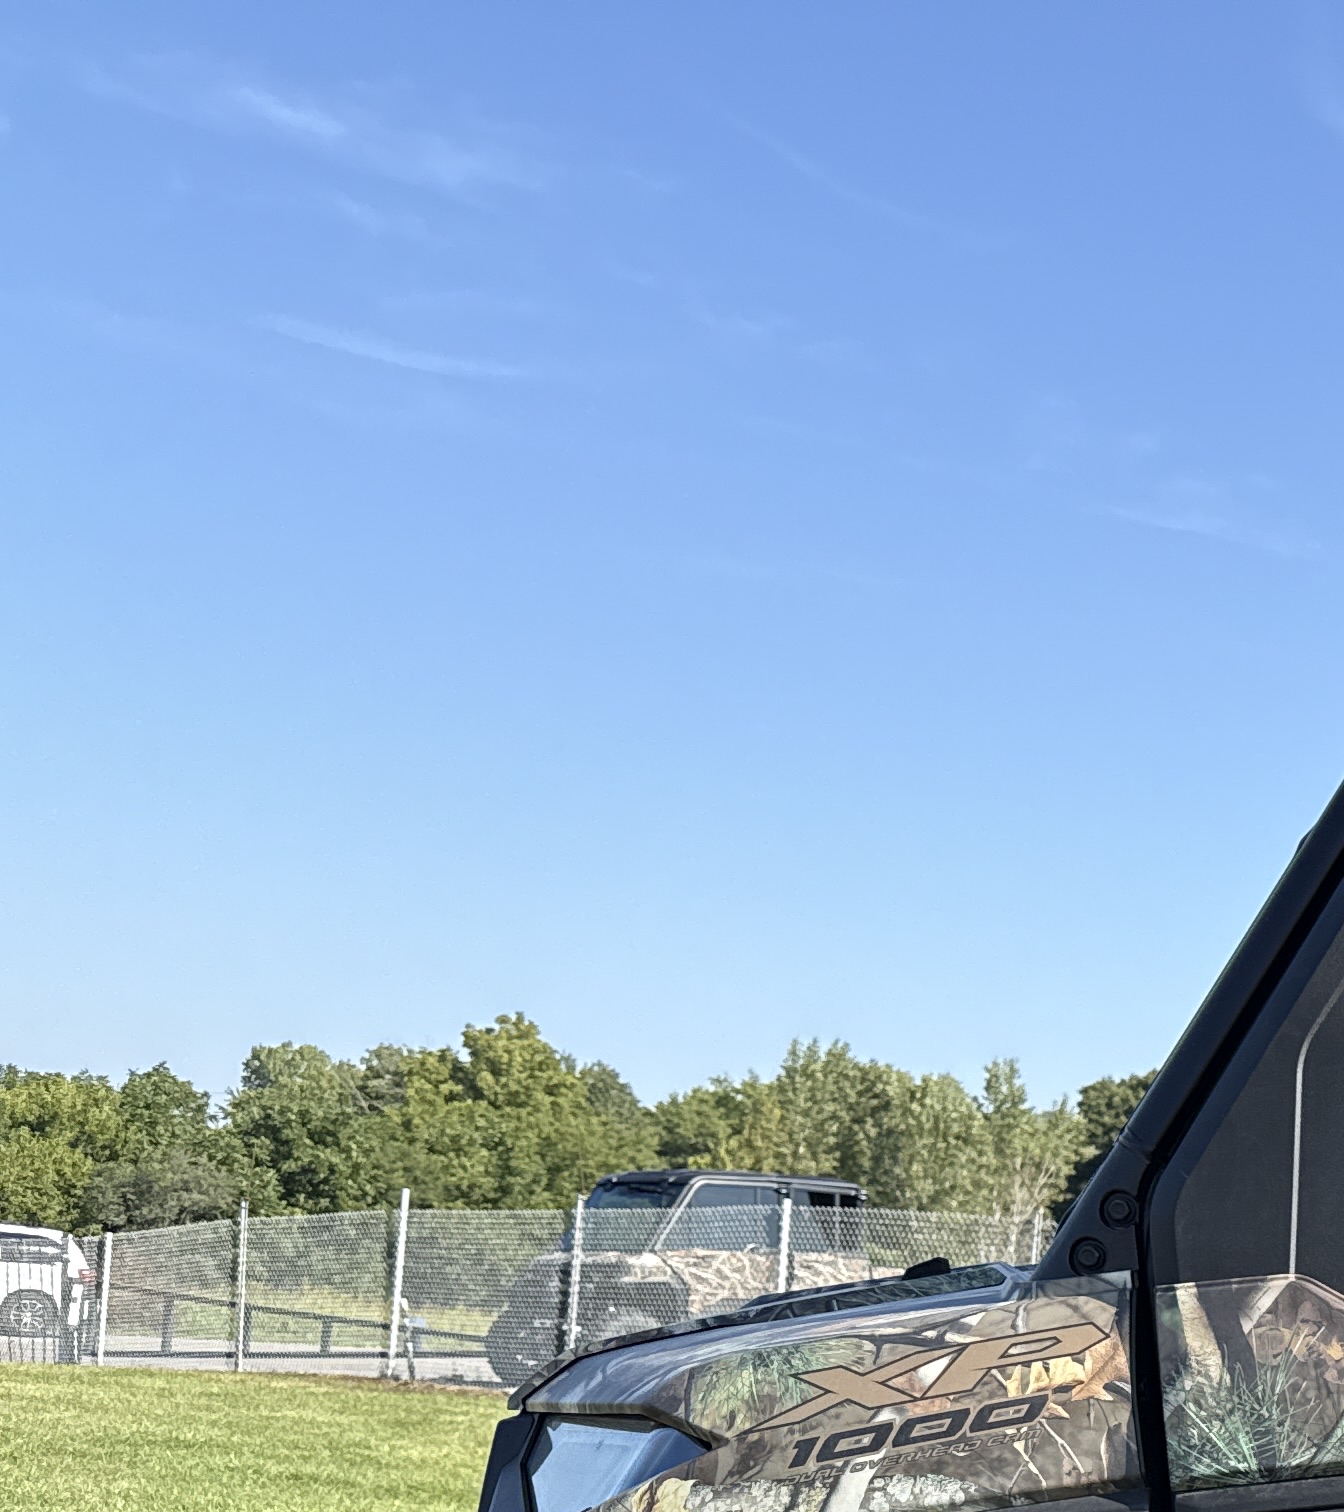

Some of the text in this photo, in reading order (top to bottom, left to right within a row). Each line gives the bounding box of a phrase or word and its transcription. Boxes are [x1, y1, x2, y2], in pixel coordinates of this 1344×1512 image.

[740, 1321, 1111, 1433] XP
[783, 1428, 1042, 1487] DUAL OVERHEAD CAM
[787, 1393, 1055, 1471] 1000
